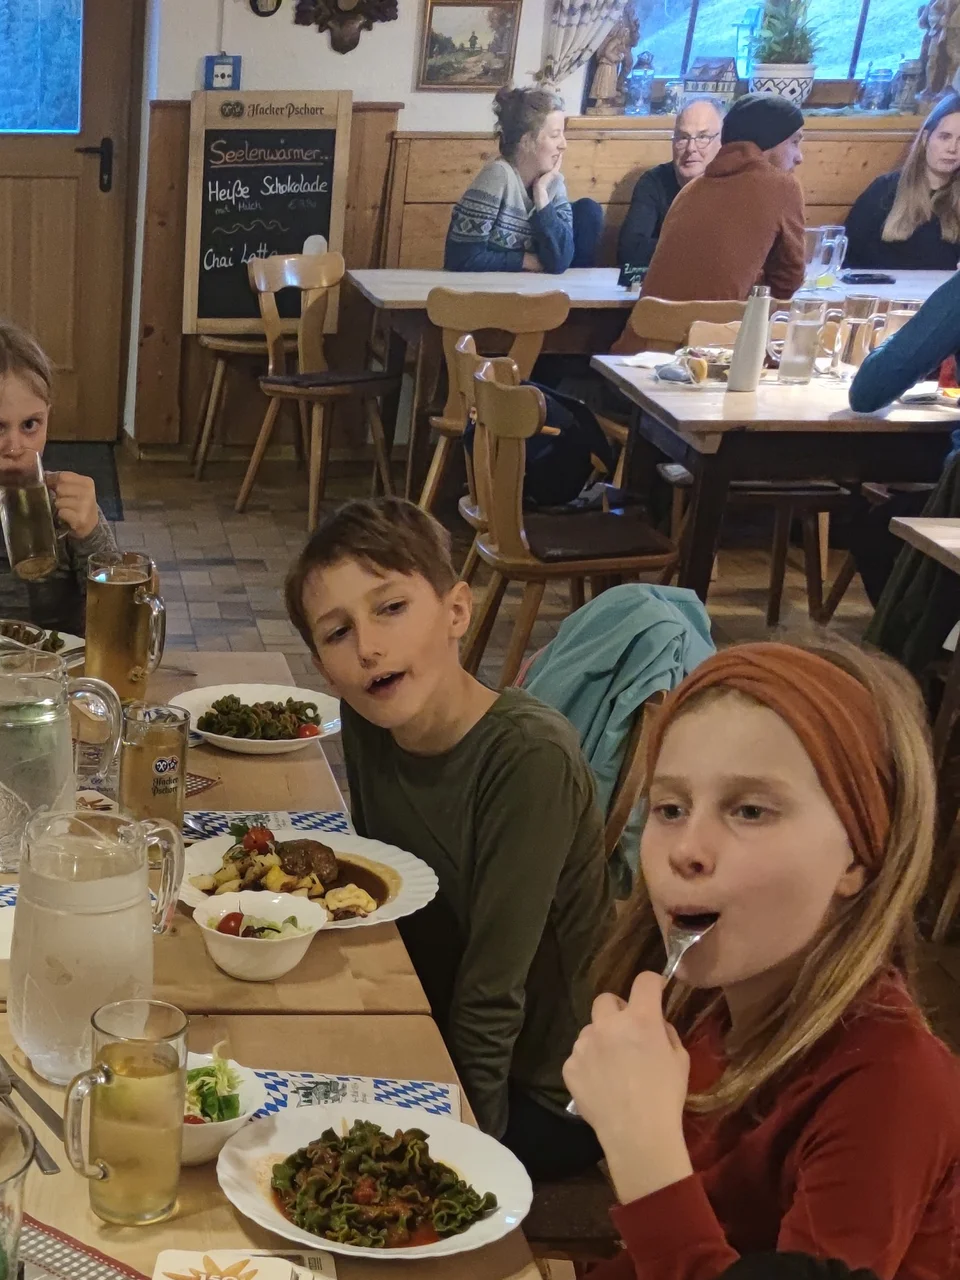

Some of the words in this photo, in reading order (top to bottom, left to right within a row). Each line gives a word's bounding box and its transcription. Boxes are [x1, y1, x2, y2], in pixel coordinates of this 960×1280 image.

[247, 104, 284, 117] Hacker
[208, 179, 250, 206] Heiße
[260, 174, 328, 195] Schokolade
[204, 247, 234, 271] Chai
